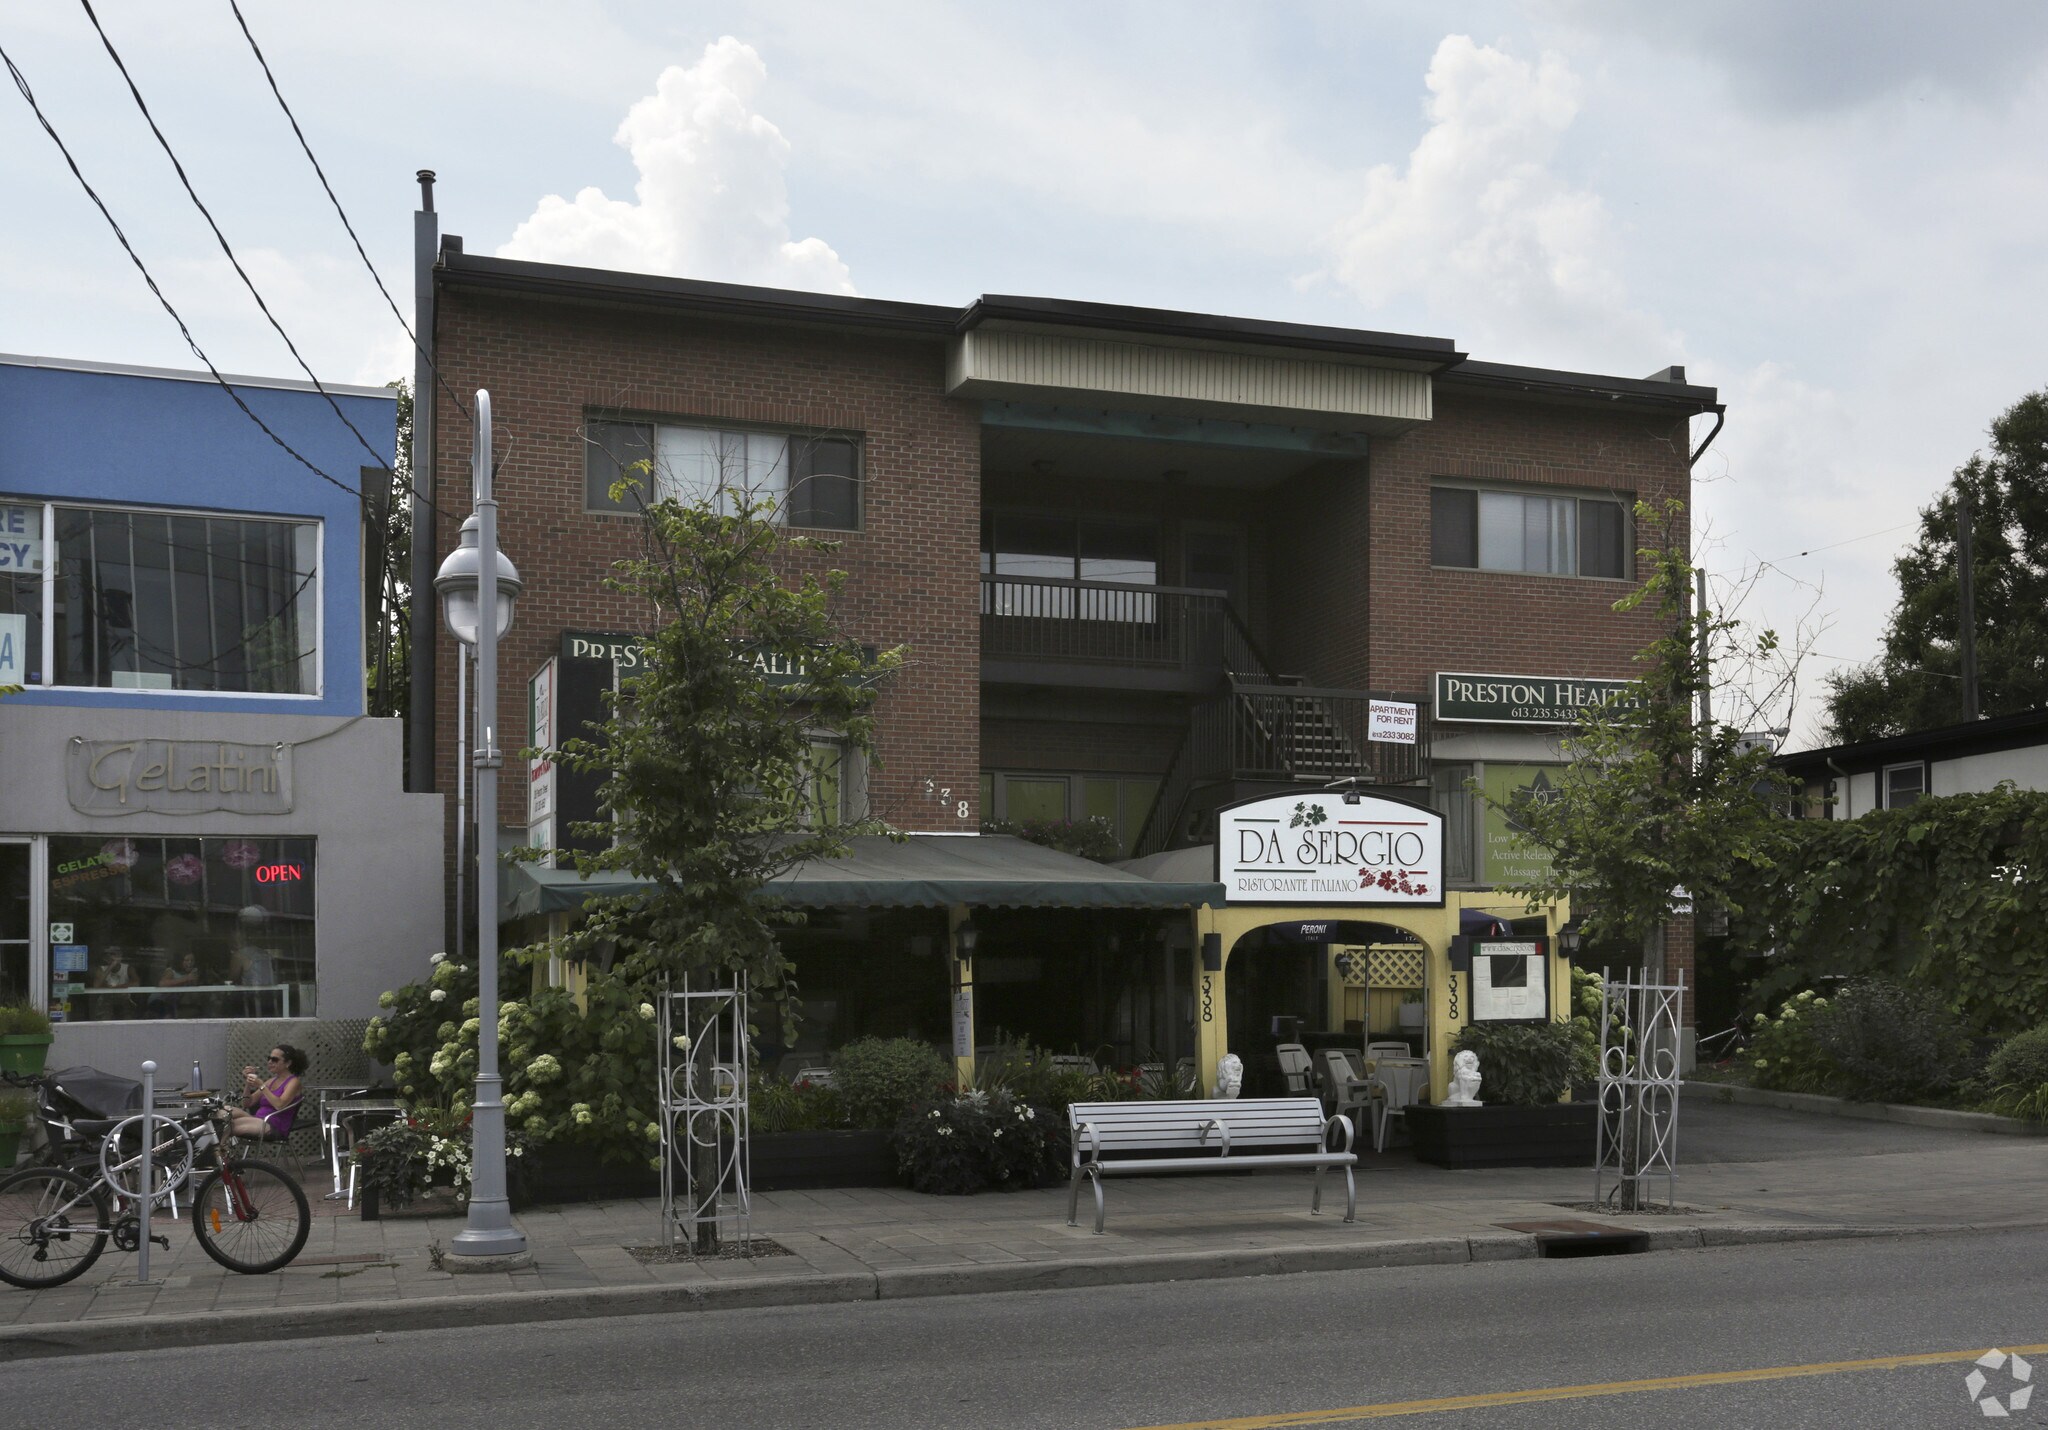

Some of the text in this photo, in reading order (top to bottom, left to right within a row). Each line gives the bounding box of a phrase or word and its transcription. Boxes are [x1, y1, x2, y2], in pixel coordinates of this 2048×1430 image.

[0, 508, 25, 533] E
[1446, 678, 1545, 705] PRESTON
[1369, 705, 1416, 716] APARTMENT
[1376, 714, 1414, 726] FOR RENT
[1511, 707, 1578, 720] 613.235.5433
[88, 743, 277, 804] Gelatini
[1238, 828, 1424, 867] DA SERGIO
[1488, 832, 1508, 843] Low
[57, 853, 116, 874] GELATO
[1491, 849, 1520, 860] Active
[52, 864, 128, 890] ESPRESSO
[255, 863, 302, 883] OPEN
[1503, 865, 1579, 880] Massage Thepy
[1238, 877, 1358, 893] RISTORANTE ITALIANO
[1300, 924, 1327, 935] PERONI
[1201, 975, 1213, 1022] 338
[1448, 974, 1459, 1020] 338
